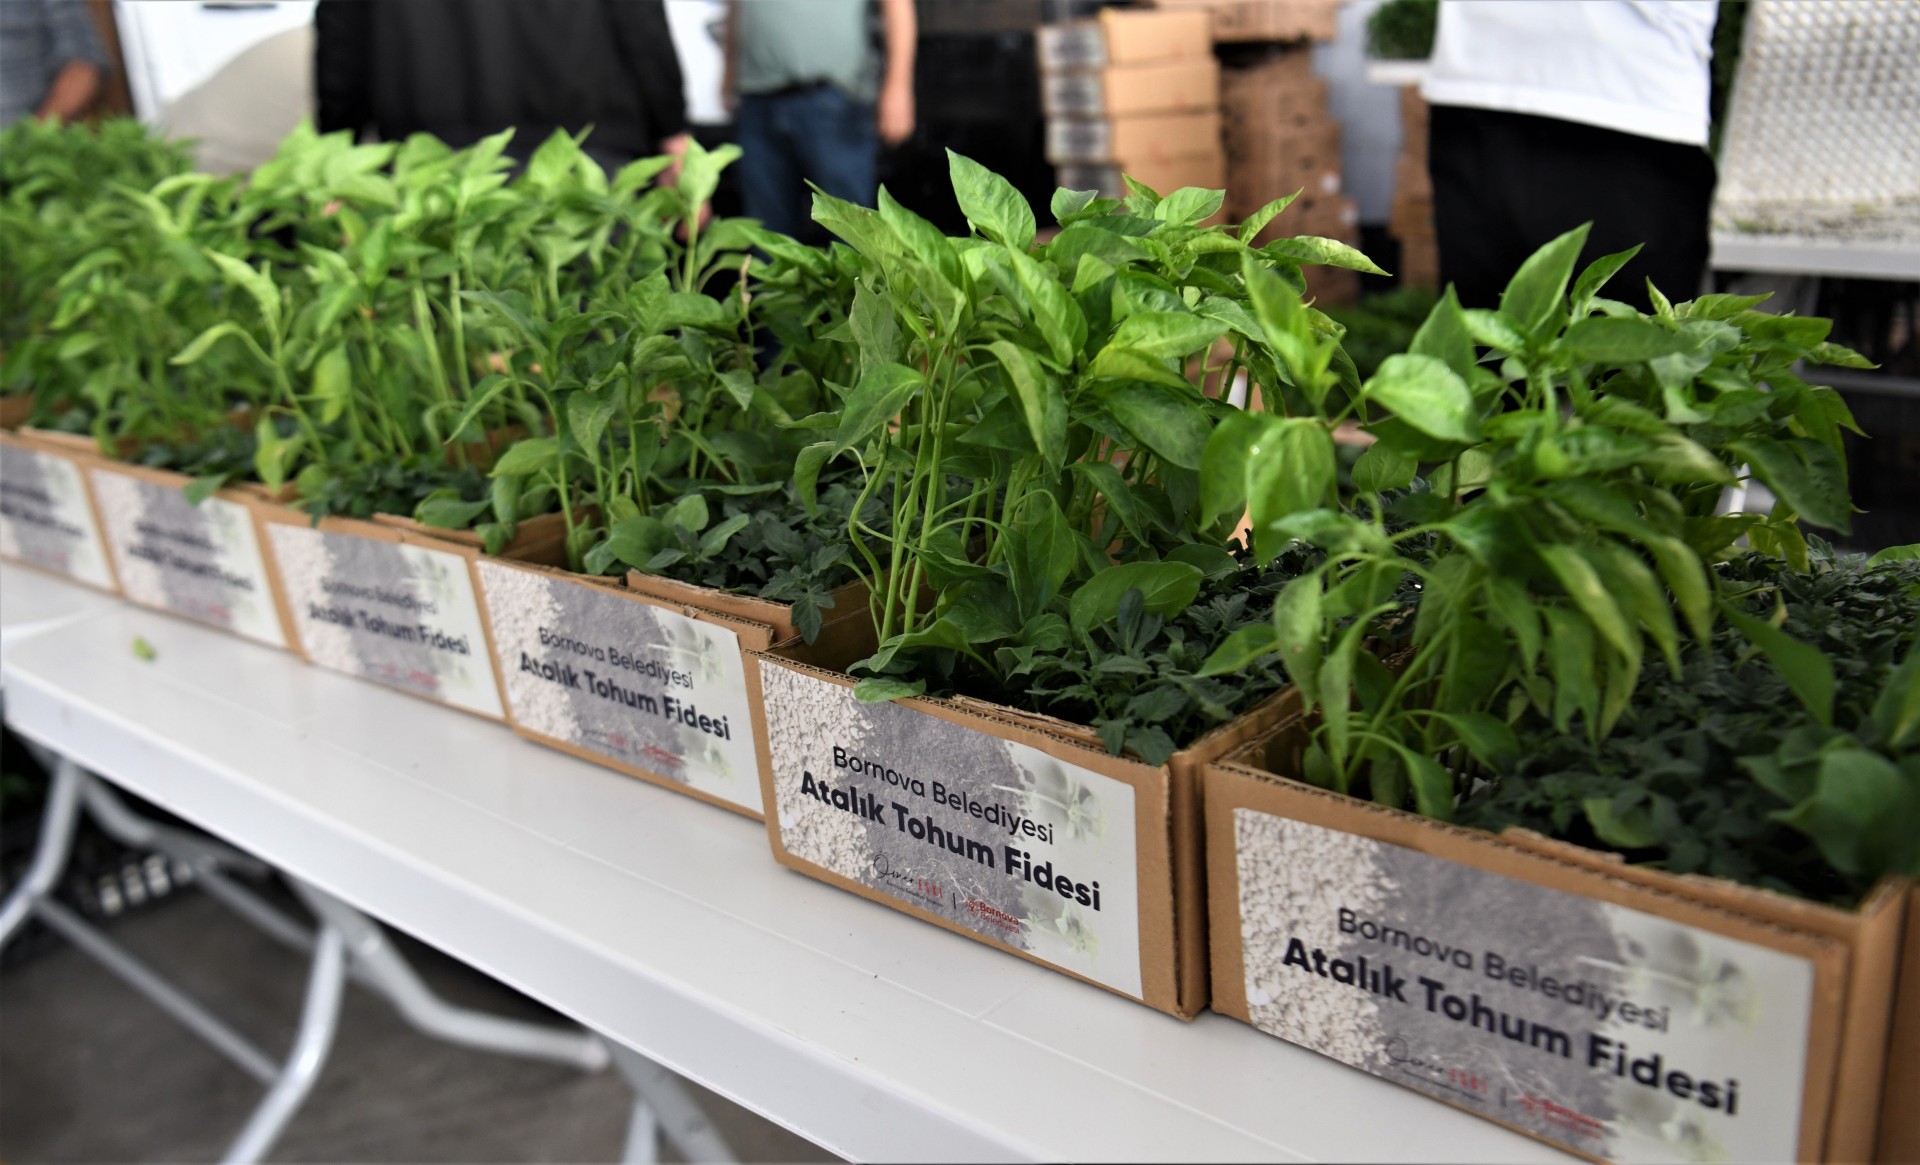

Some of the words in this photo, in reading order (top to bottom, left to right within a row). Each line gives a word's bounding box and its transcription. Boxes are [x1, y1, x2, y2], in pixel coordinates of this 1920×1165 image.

[520, 651, 581, 690] Atalık
[584, 671, 658, 715] Tohum
[664, 695, 731, 741] Fidesi
[538, 627, 605, 662] Bornova
[609, 646, 693, 689] Belediyesi
[800, 770, 886, 826] Atalık
[891, 801, 995, 869] Tohum
[1004, 846, 1101, 912] Fidesi
[833, 746, 926, 798] Bornova
[932, 780, 1054, 846] Belediyesi
[980, 902, 1020, 926] Bornova
[1337, 906, 1475, 971] Bornova
[1484, 951, 1670, 1034] Belediyesi
[1282, 937, 1408, 1004] Atalık
[1418, 976, 1572, 1060] Tohum
[1586, 1034, 1740, 1116] Fidesi
